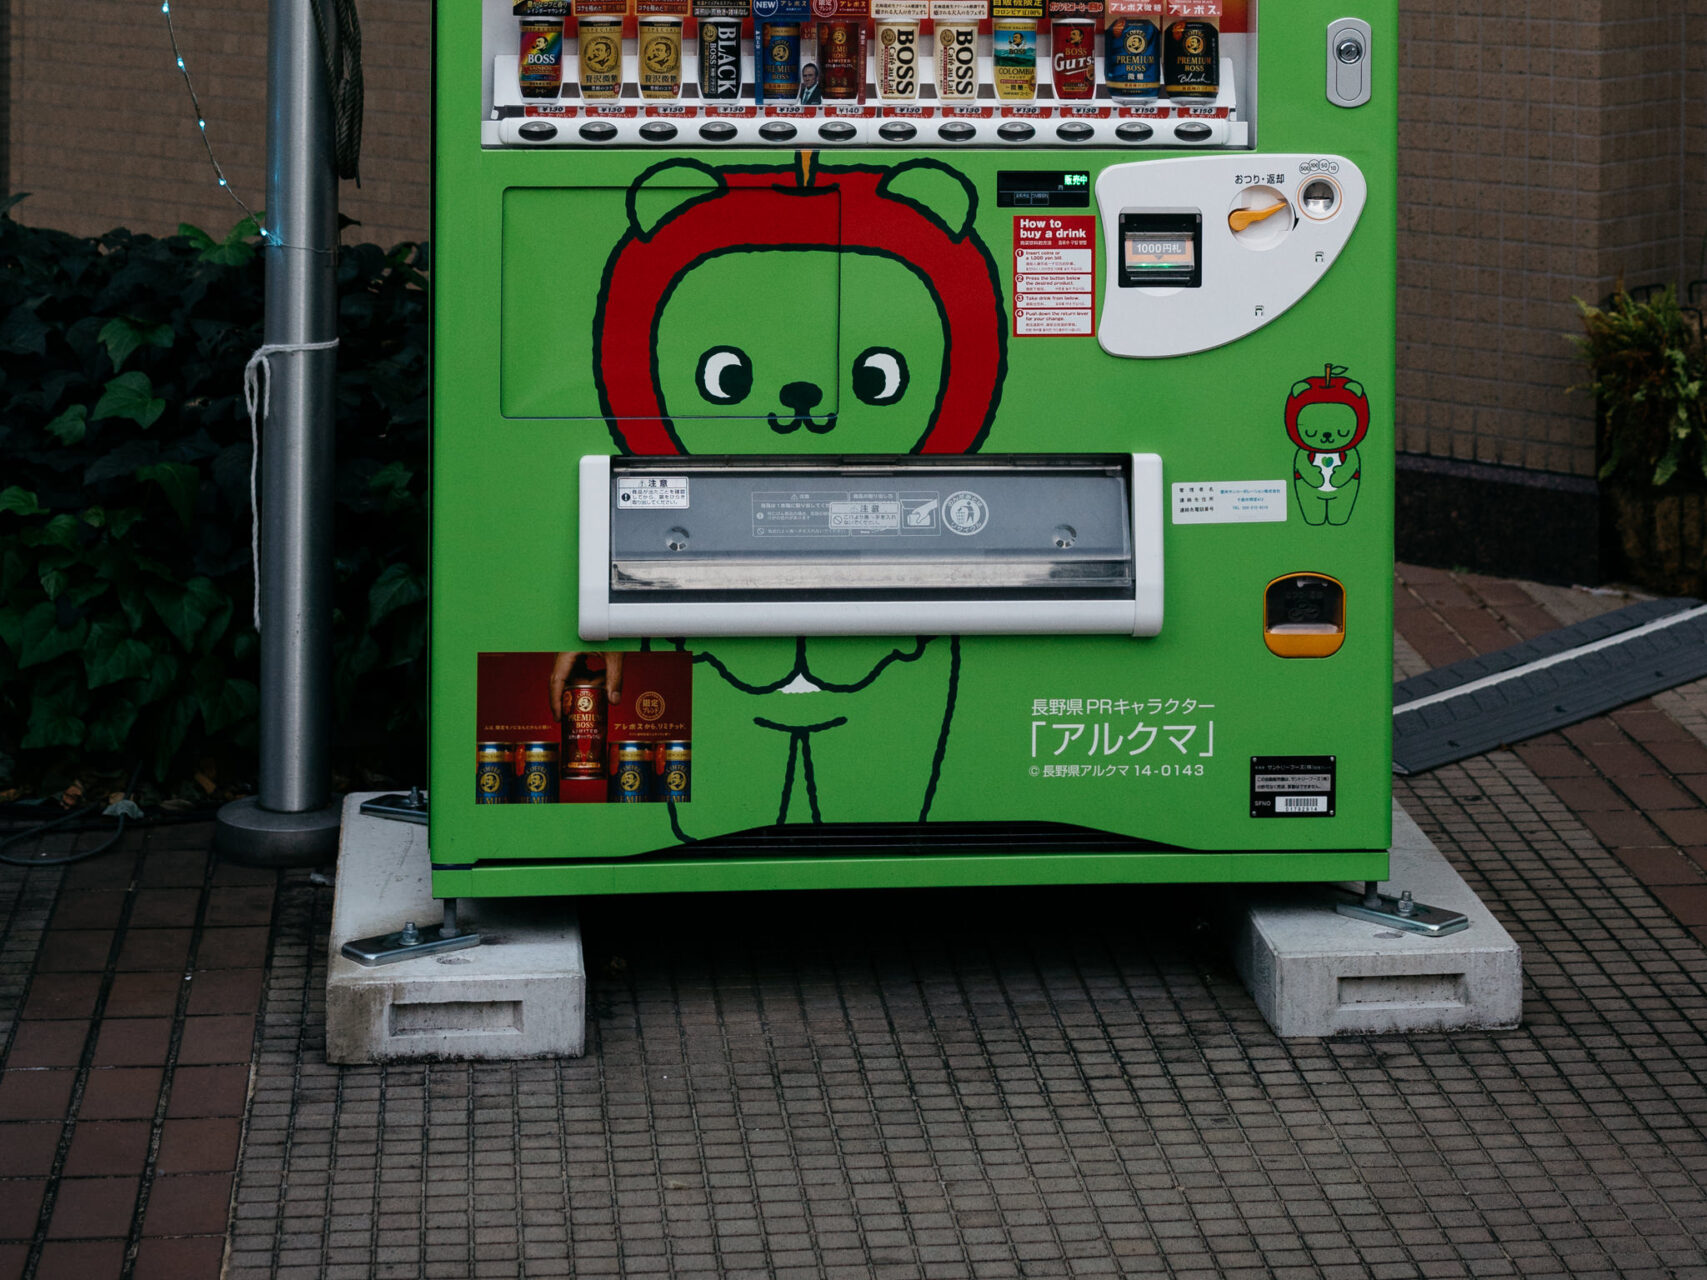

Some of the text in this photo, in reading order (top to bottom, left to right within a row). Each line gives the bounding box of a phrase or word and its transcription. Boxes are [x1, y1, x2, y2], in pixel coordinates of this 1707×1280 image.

[755, 0, 775, 9] NEW
[818, 0, 832, 7] 限定
[1111, 2, 1162, 13] プレボス微糖
[995, 9, 1041, 17] コロンビア豆100%
[1065, 47, 1087, 56] BOSS
[527, 53, 556, 64] BOSS
[717, 26, 737, 94] BLACK
[896, 29, 915, 95] BOSS
[955, 29, 974, 95] BOSS
[1116, 55, 1155, 64] PREMIUM
[1177, 56, 1212, 65] PREMIUM
[999, 67, 1035, 75] COLOMBIA
[1125, 64, 1147, 72] BOSS
[1184, 64, 1205, 72] BOSS
[585, 75, 619, 83] 贅沢微糖
[644, 75, 678, 83] 贅沢微糖
[1177, 72, 1211, 84] Black
[1320, 162, 1328, 170] 50
[1063, 174, 1088, 186] 販売中
[1234, 173, 1286, 185] おつり・返却
[1020, 218, 1062, 228] How to
[1020, 228, 1087, 239] buy a drink
[1136, 243, 1182, 254] 1000円札
[647, 479, 668, 488] 注意
[859, 504, 880, 513] 注意
[642, 699, 658, 707] 限定
[1031, 698, 1216, 716] 長野県PRキャラクター
[575, 721, 595, 729] BOSS
[1031, 720, 1214, 758] 「アルクマ」
[1134, 764, 1204, 776] 14-0143
